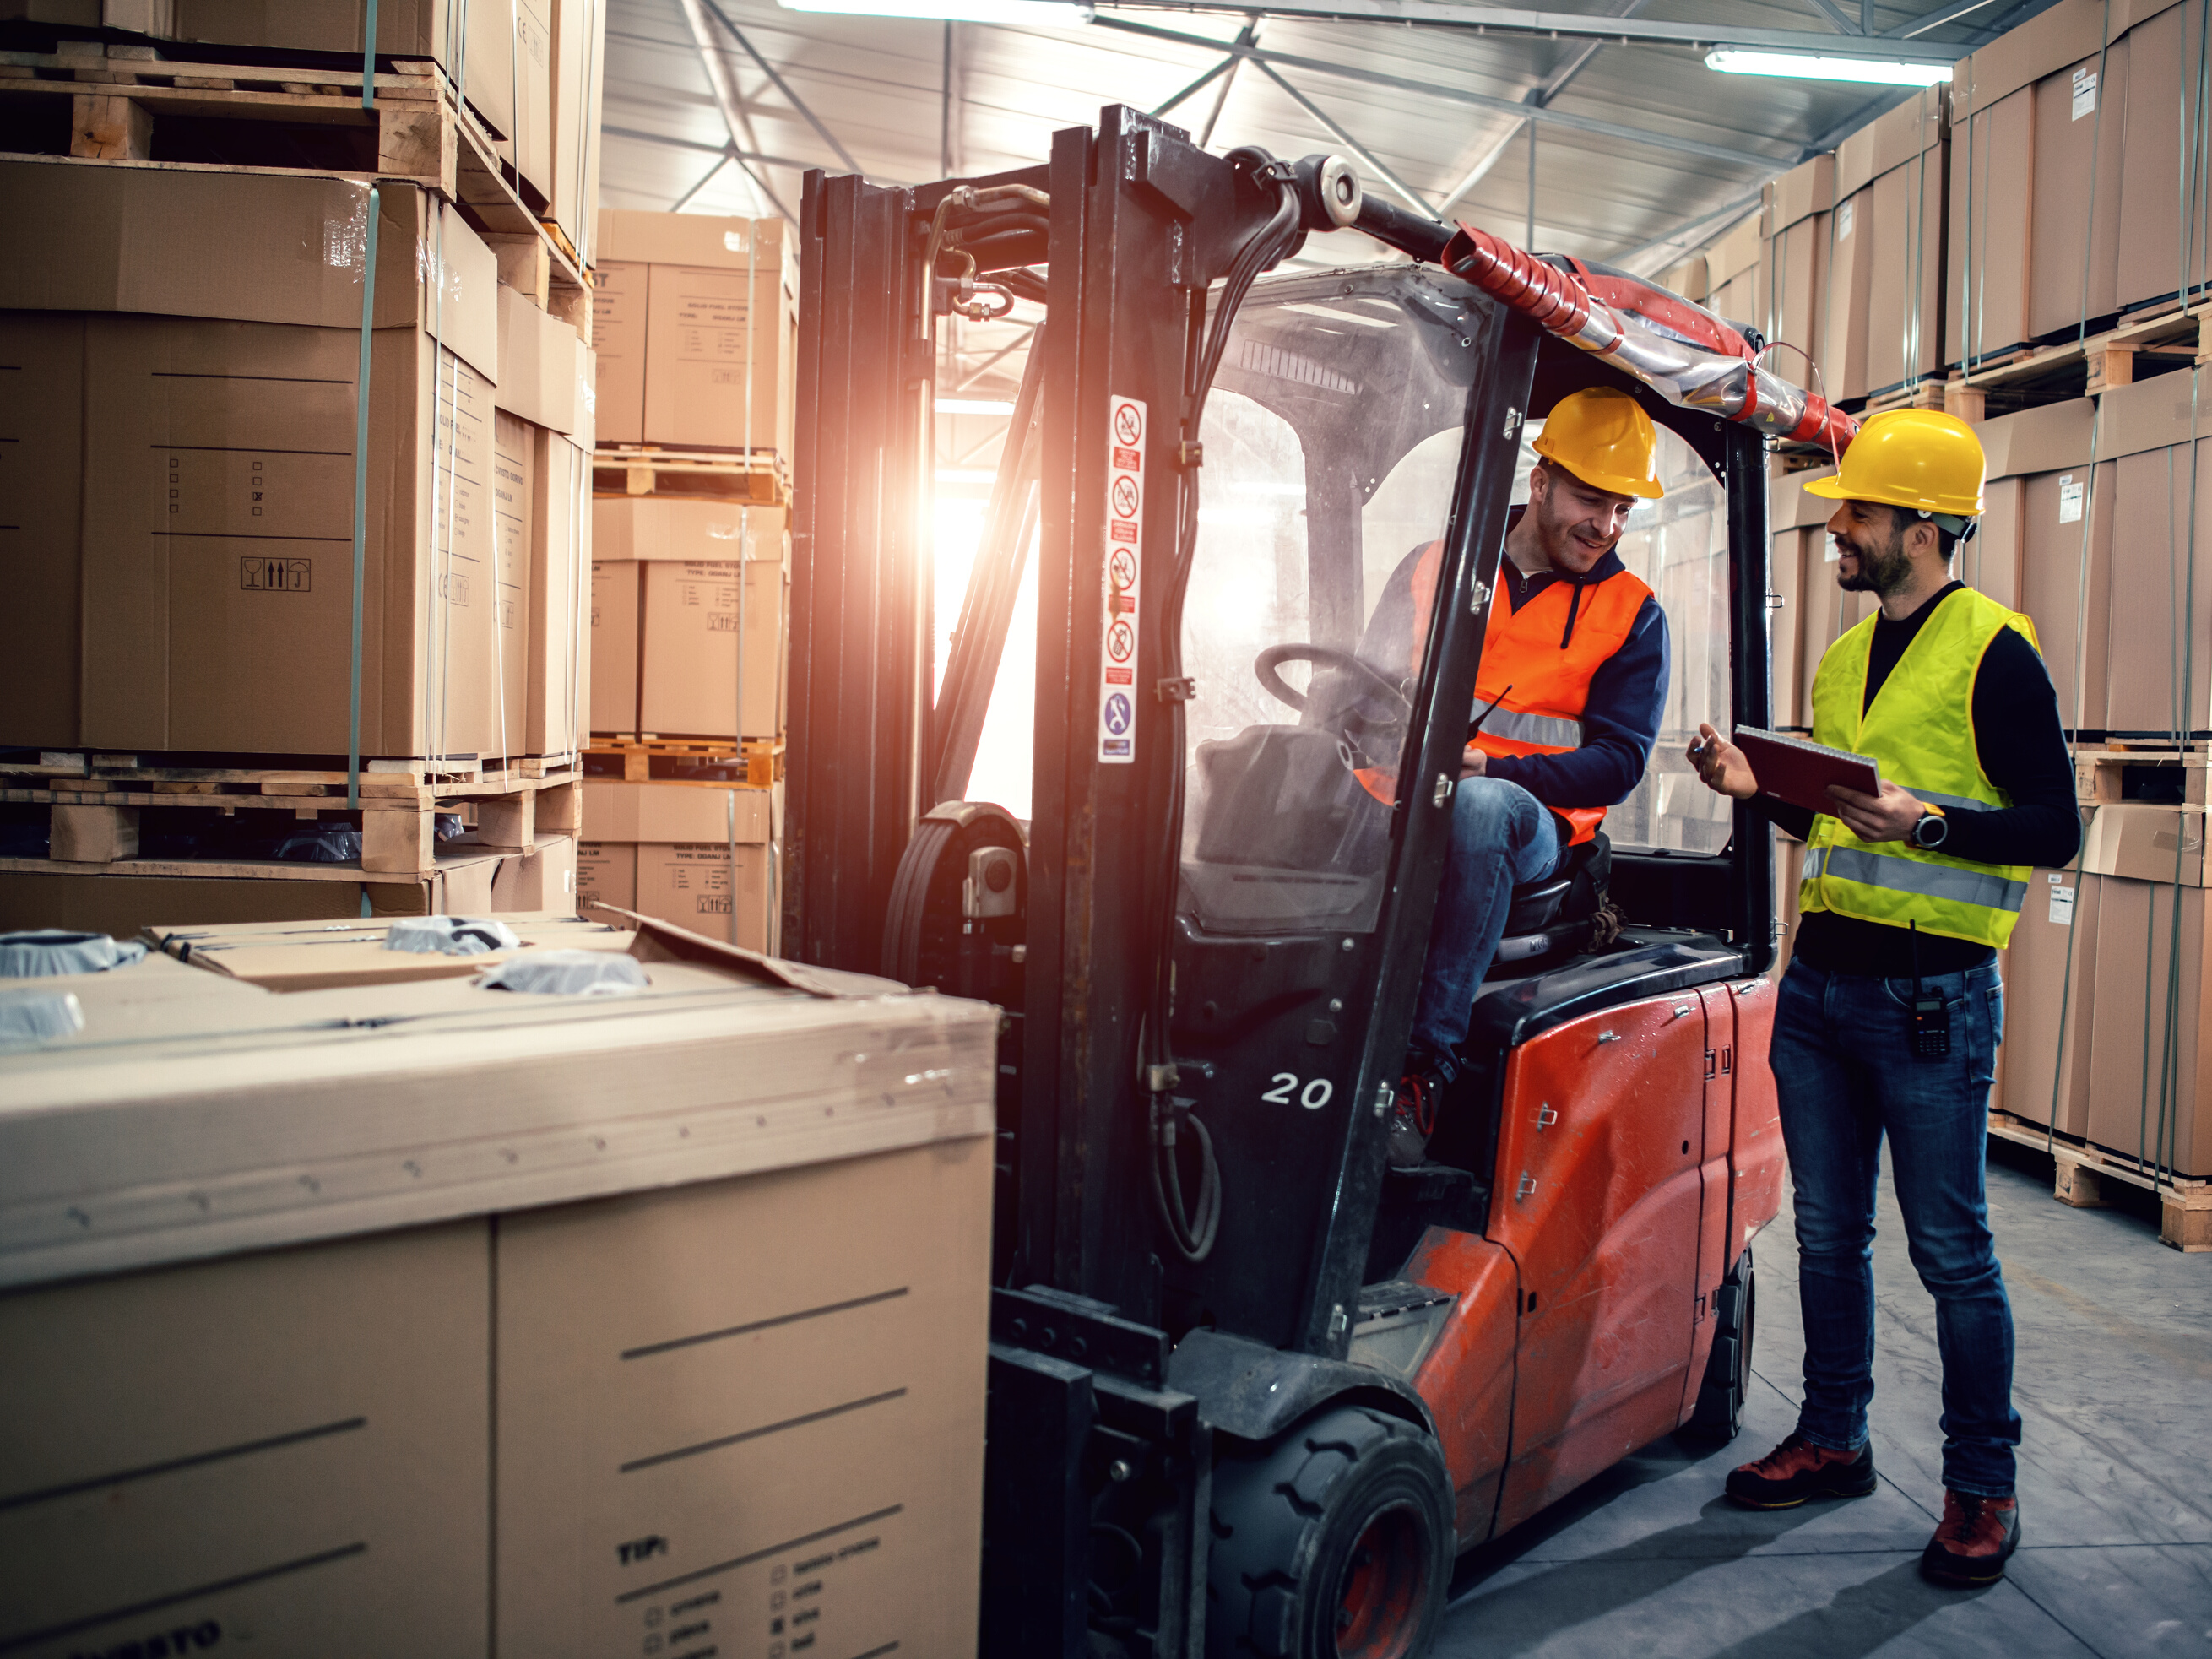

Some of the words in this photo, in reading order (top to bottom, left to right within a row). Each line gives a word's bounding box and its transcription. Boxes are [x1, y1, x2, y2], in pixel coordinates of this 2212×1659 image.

[439, 414, 450, 428] OLID
[450, 420, 461, 435] FEL
[1261, 1071, 1334, 1110] 20
